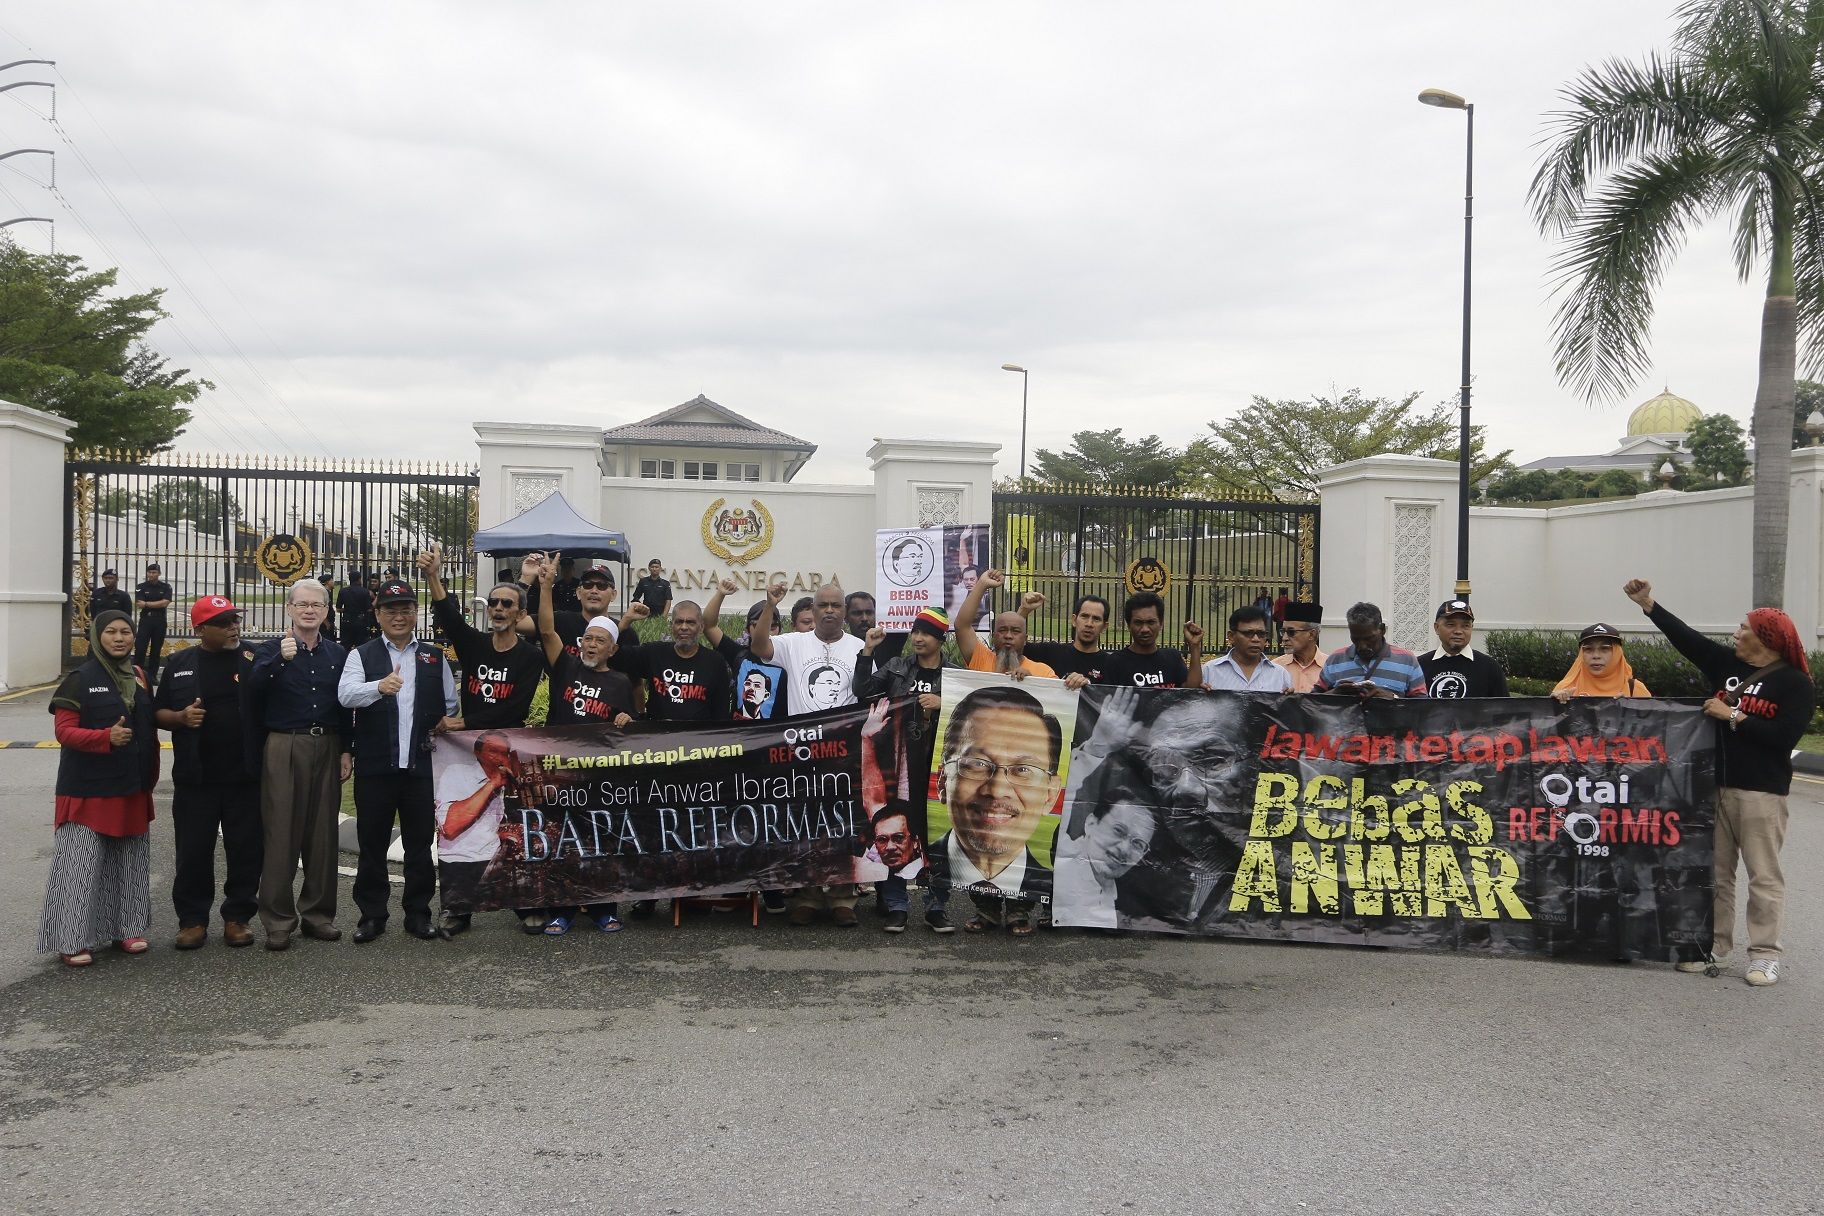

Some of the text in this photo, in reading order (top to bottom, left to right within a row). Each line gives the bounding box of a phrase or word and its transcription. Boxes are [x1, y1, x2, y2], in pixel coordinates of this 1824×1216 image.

[627, 567, 720, 590] ISANA
[889, 590, 929, 601] BEBAS
[477, 664, 509, 682] Otai
[663, 668, 695, 684] Otai
[1133, 670, 1164, 688] Otai
[1725, 676, 1763, 695] Oai
[784, 724, 823, 745] Otai
[542, 743, 744, 770] #LawanTetapLawan
[769, 740, 848, 764] REFORMIS
[1257, 723, 1669, 772] lawan tetap lawan
[600, 780, 639, 806] Seri
[647, 779, 724, 804] Anwar
[735, 766, 852, 801] Ibrahim
[1539, 773, 1630, 806] Otai
[517, 800, 858, 862] BAPA REFORMASI
[1508, 806, 1681, 846] REFORMIS
[1576, 844, 1610, 857] 1998
[1228, 840, 1533, 920] ANWAR
